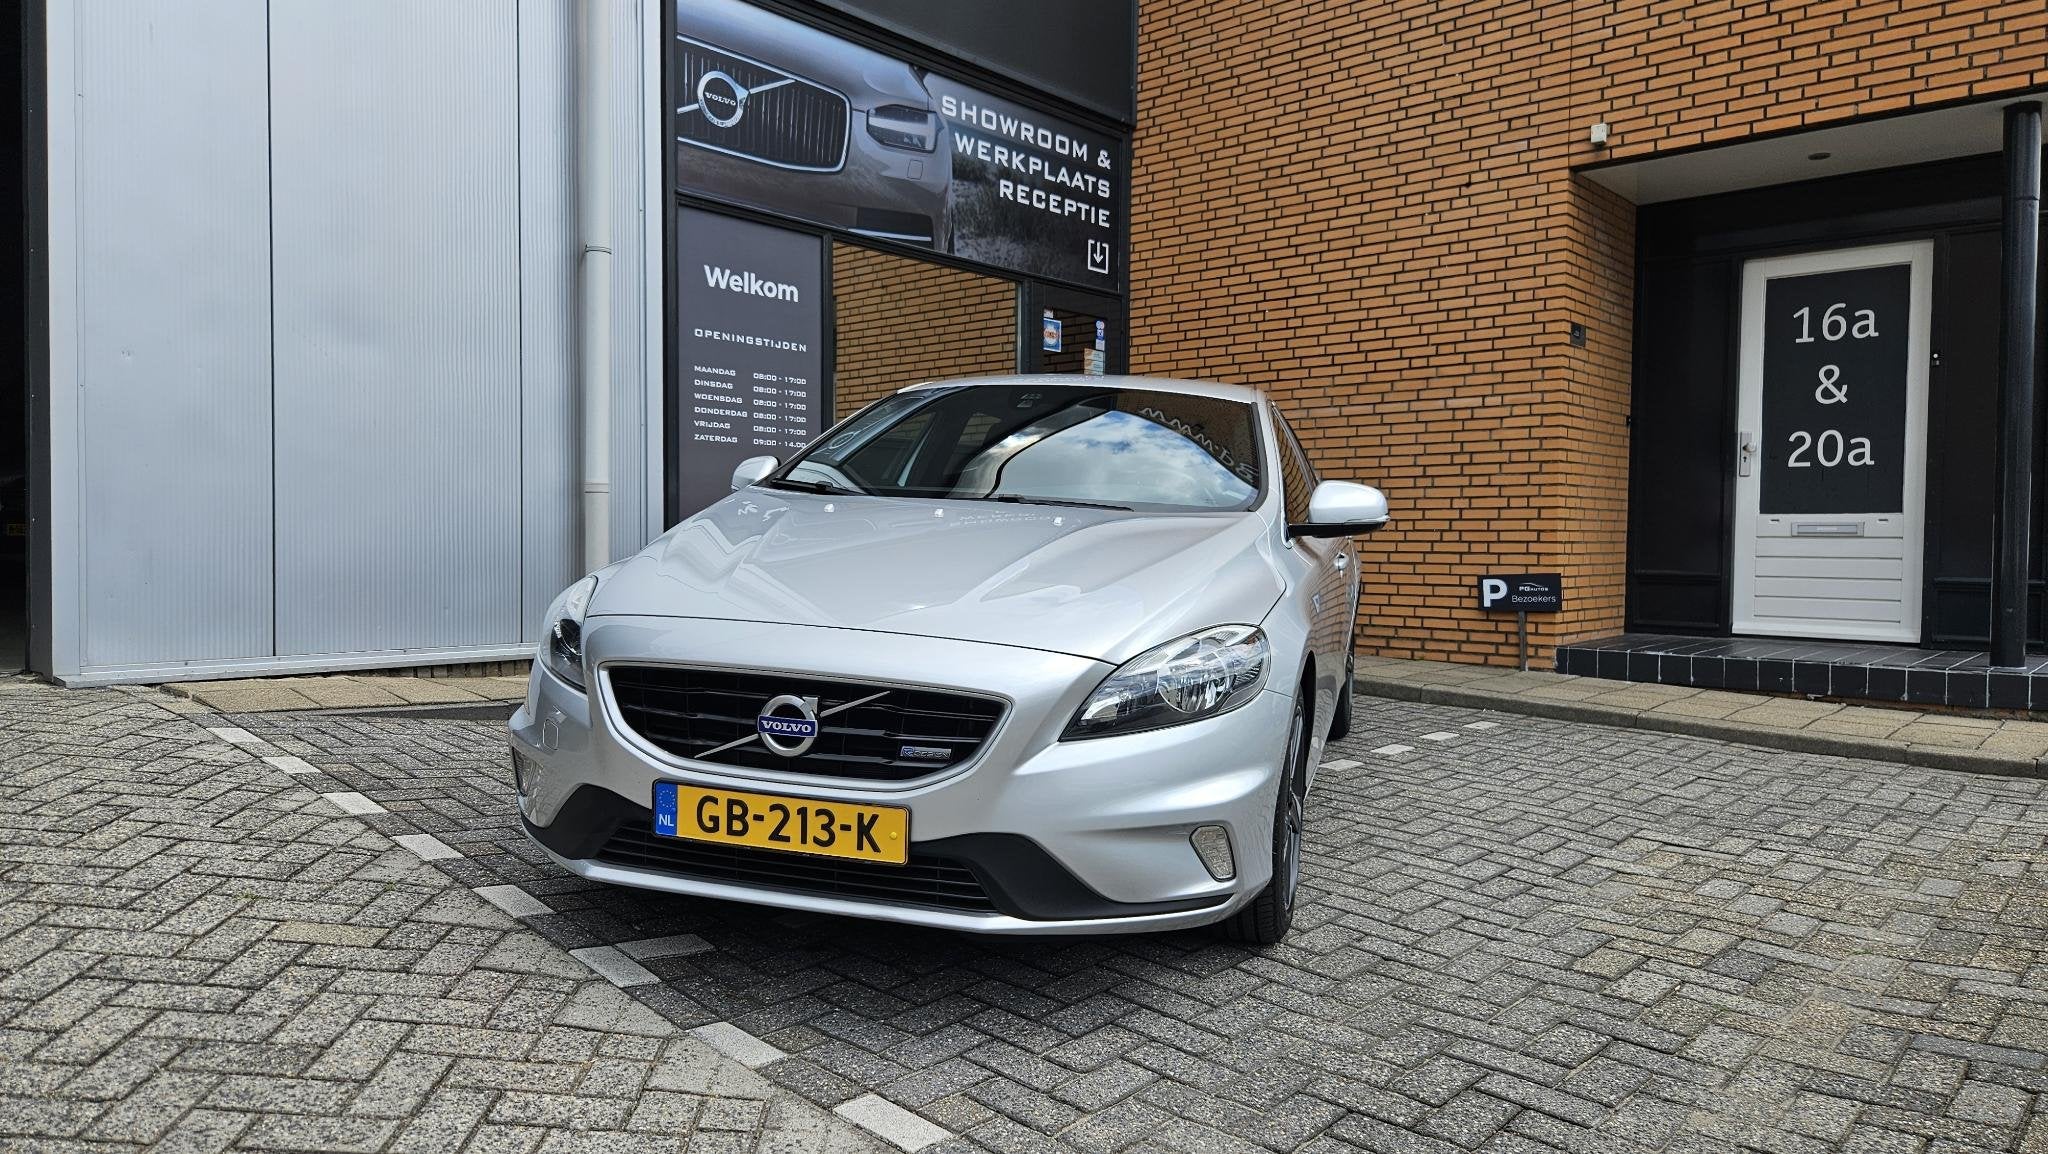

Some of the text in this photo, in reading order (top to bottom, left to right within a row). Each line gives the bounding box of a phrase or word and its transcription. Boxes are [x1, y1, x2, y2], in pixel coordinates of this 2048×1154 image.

[704, 91, 736, 106] VOLVO
[942, 95, 1111, 170] SHOWROOM &
[954, 131, 1110, 198] WERKPLAATS
[999, 179, 1110, 228] RECEPTIE
[703, 264, 799, 303] Welkom
[1793, 302, 1879, 343] 16a
[694, 327, 807, 353] OPENINGSTIJDEN
[694, 365, 736, 377] MAANDAG
[753, 372, 777, 382] 08:00
[784, 376, 806, 385] 17:00
[1815, 364, 1848, 404] &
[694, 379, 734, 390] DINSDAG
[753, 385, 777, 395] 08:00
[784, 389, 806, 398] 17:00
[694, 392, 743, 404] WOENSDAG
[753, 399, 777, 408] 08:00
[784, 402, 806, 411] 17:00
[694, 406, 748, 418] DONDERDAG
[753, 412, 777, 421] 08:00
[784, 415, 806, 423] 17:00
[693, 420, 731, 429] VRIJDAG
[753, 425, 777, 434] 08:00
[784, 428, 806, 436] 17:00
[694, 433, 738, 443] ZATERDAG
[753, 438, 777, 446] 09:00
[1788, 429, 1875, 468] 20a
[1482, 578, 1508, 608] P
[1511, 595, 1556, 603] Bezoekers
[761, 720, 812, 733] VOLVO
[658, 812, 675, 828] NL
[696, 795, 882, 853] GB-213-K
